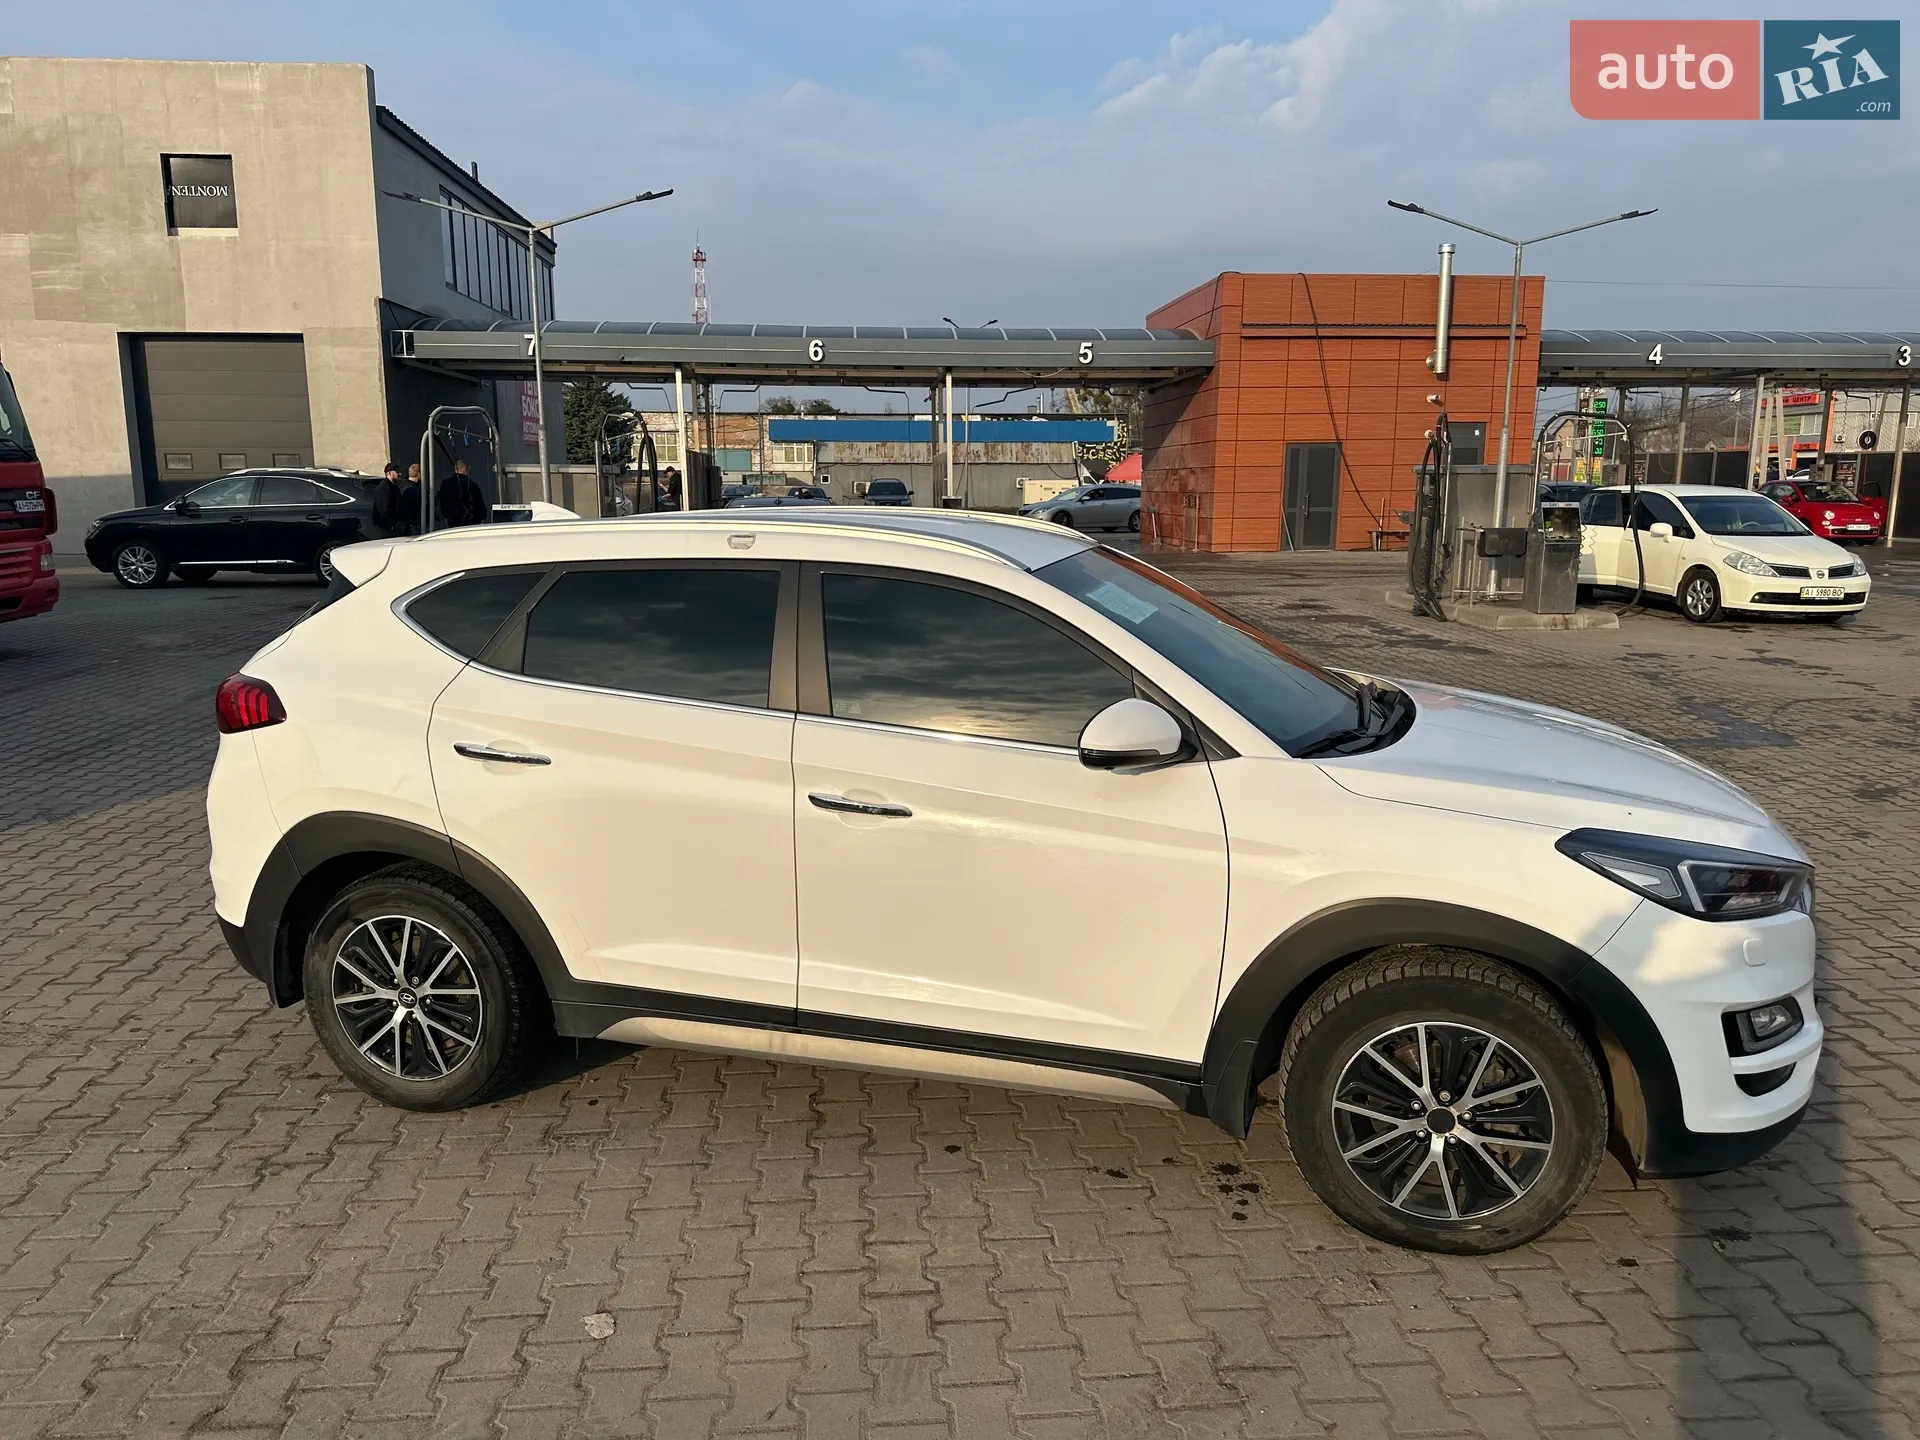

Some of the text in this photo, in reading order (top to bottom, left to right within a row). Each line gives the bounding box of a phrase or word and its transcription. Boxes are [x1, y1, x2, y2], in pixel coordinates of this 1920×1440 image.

[524, 333, 536, 356] 7
[809, 339, 824, 362] 6
[1078, 341, 1093, 364] 5
[1648, 343, 1663, 365] 4
[1898, 345, 1912, 366] 3
[1816, 588, 1831, 597] 5980
